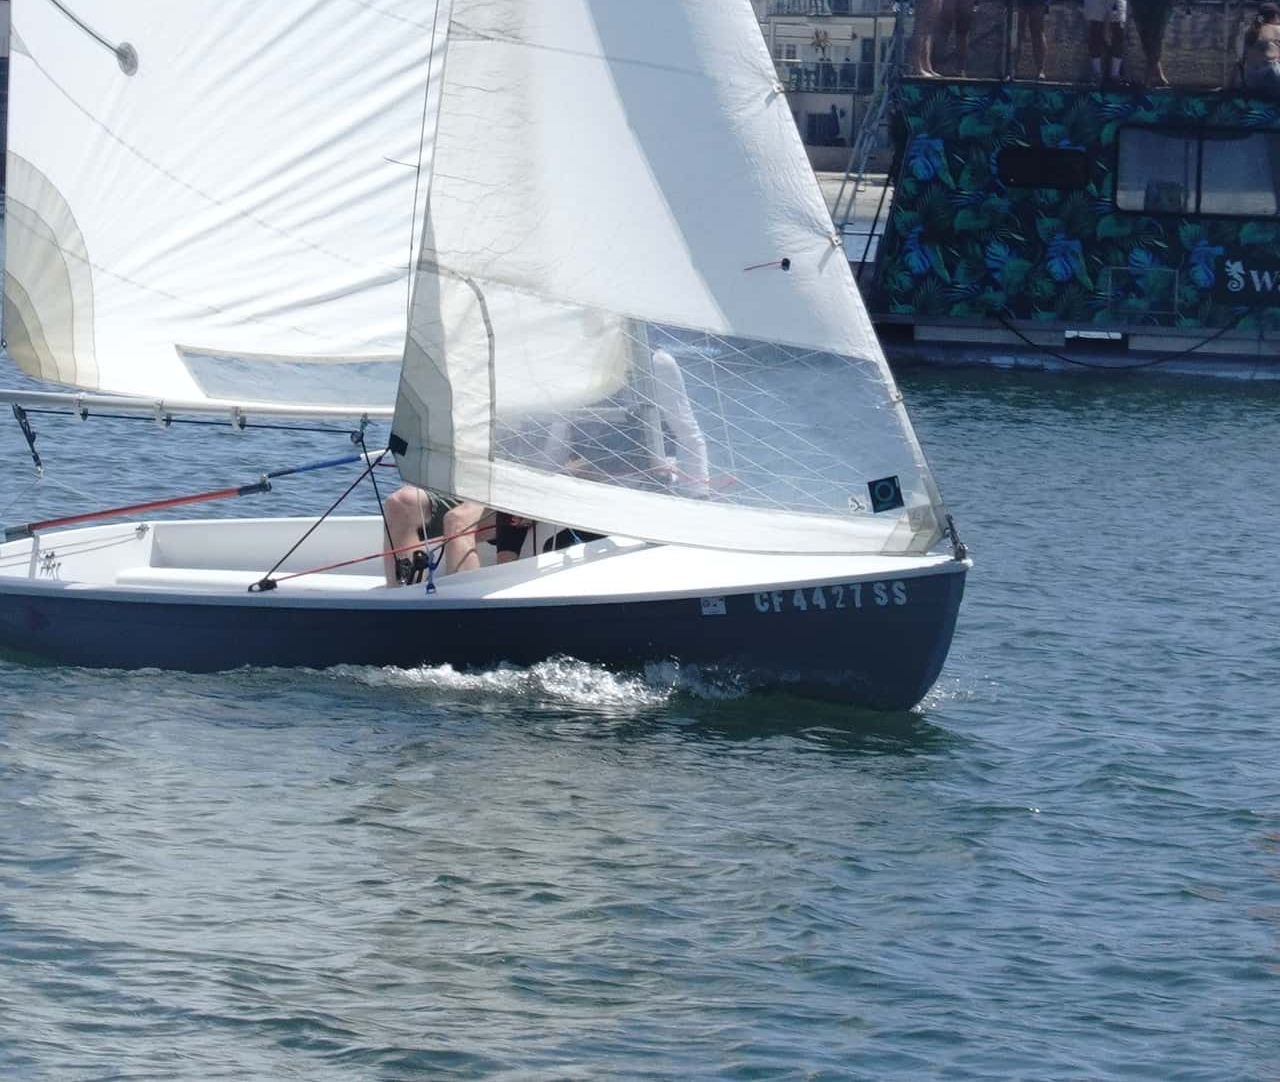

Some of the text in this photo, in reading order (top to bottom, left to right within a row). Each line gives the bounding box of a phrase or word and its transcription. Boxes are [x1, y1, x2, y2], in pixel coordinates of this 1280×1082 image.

[753, 581, 907, 613] CF 4427 SS
